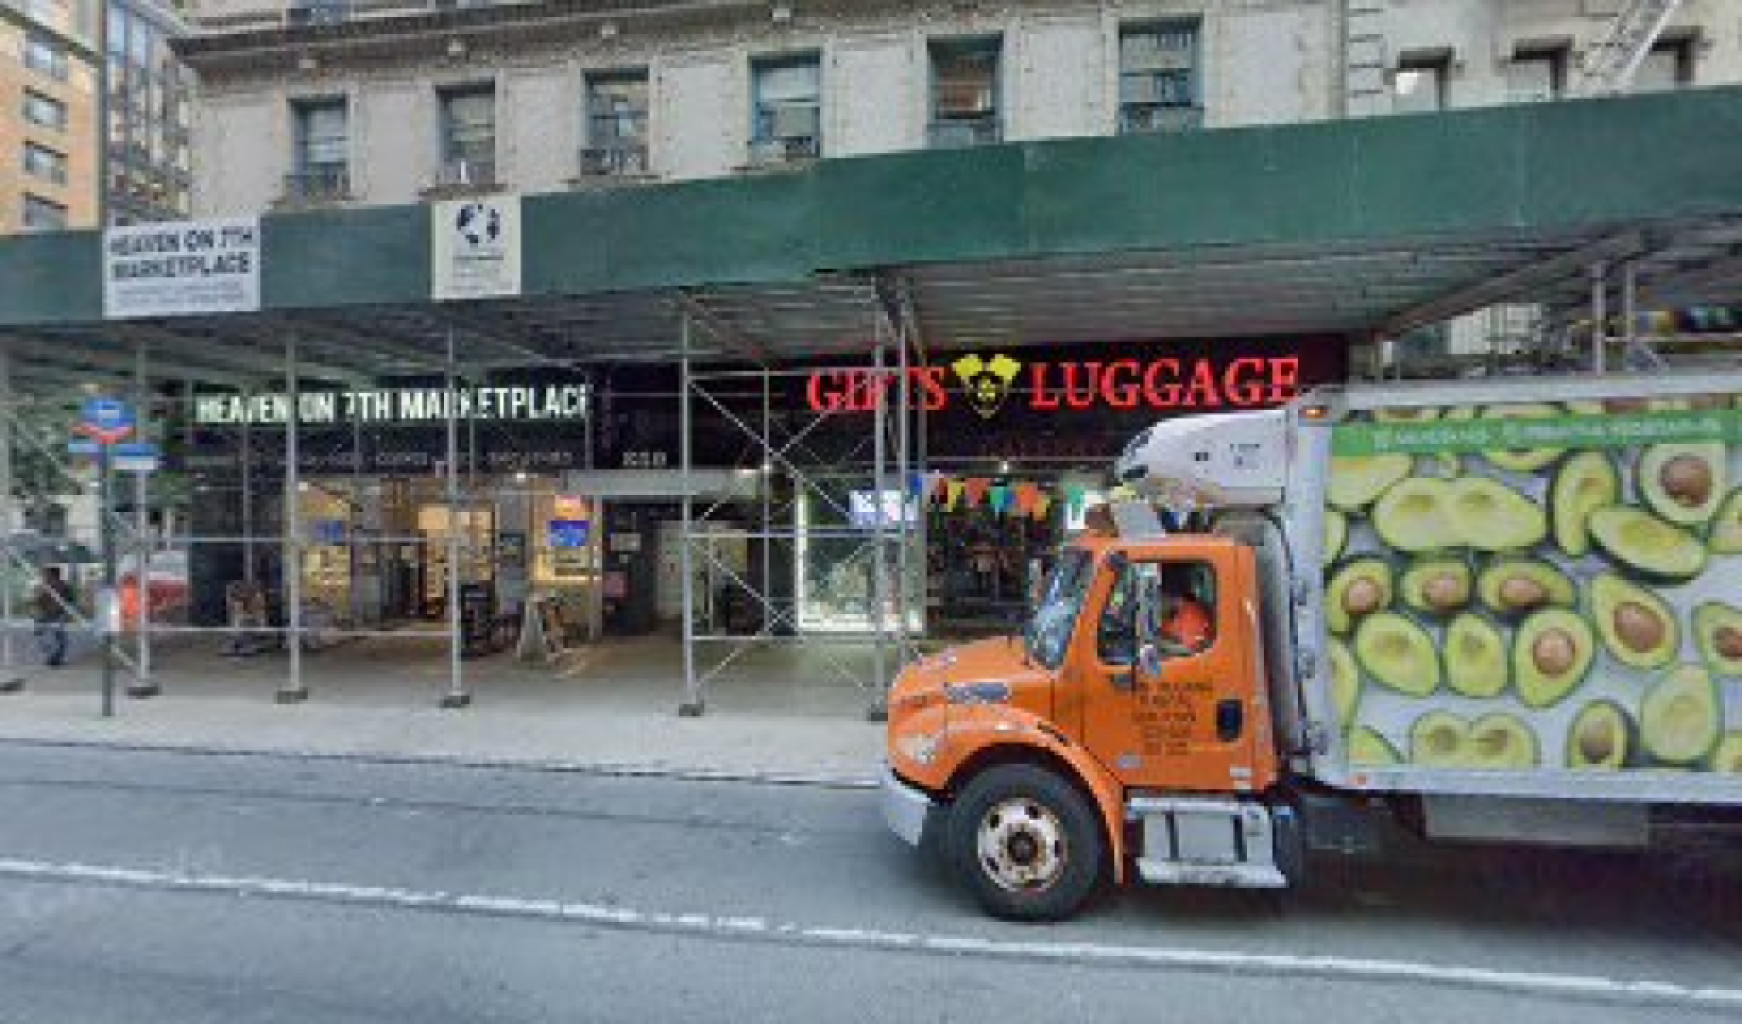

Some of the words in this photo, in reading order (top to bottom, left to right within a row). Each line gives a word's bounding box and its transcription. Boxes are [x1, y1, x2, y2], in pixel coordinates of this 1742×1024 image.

[184, 229, 214, 252] ON
[1029, 358, 1300, 412] LUGGAGE
[300, 392, 335, 423] ON
